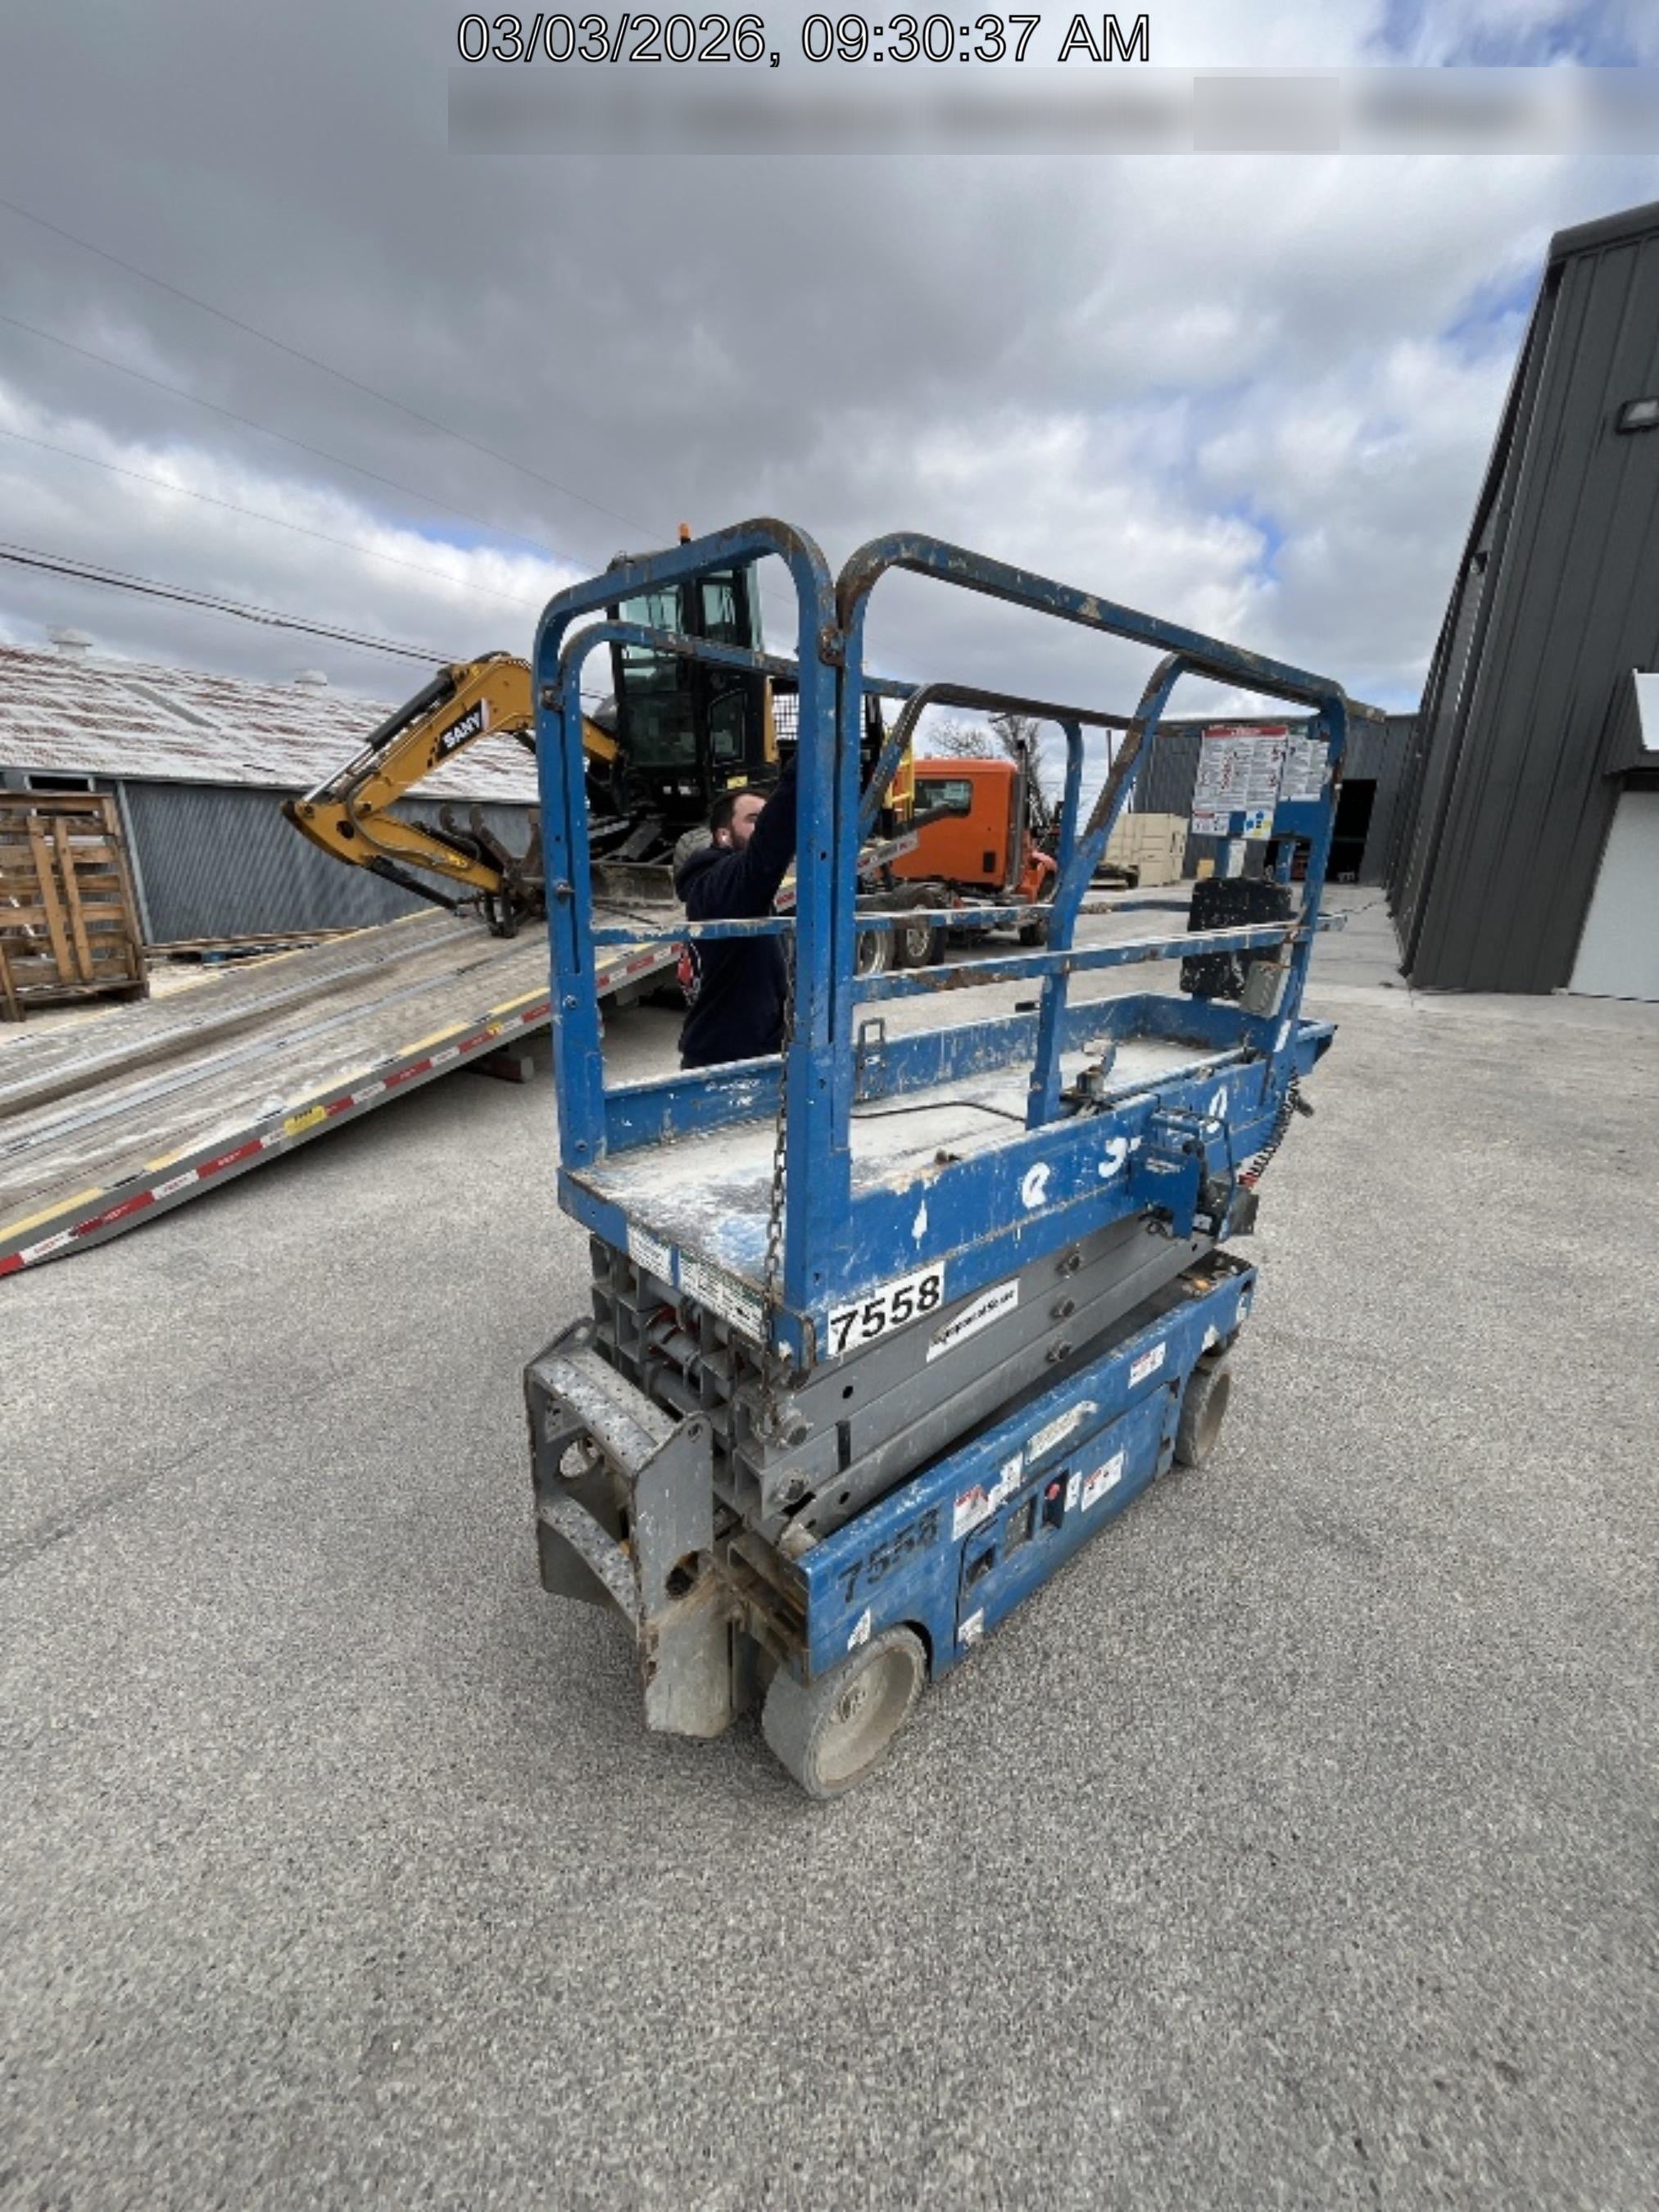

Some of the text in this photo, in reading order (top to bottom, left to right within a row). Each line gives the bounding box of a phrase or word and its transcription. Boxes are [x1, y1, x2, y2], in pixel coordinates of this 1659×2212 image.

[442, 711, 481, 749] SANY
[830, 1275, 941, 1353] 7558
[837, 1507, 939, 1603] 7558
